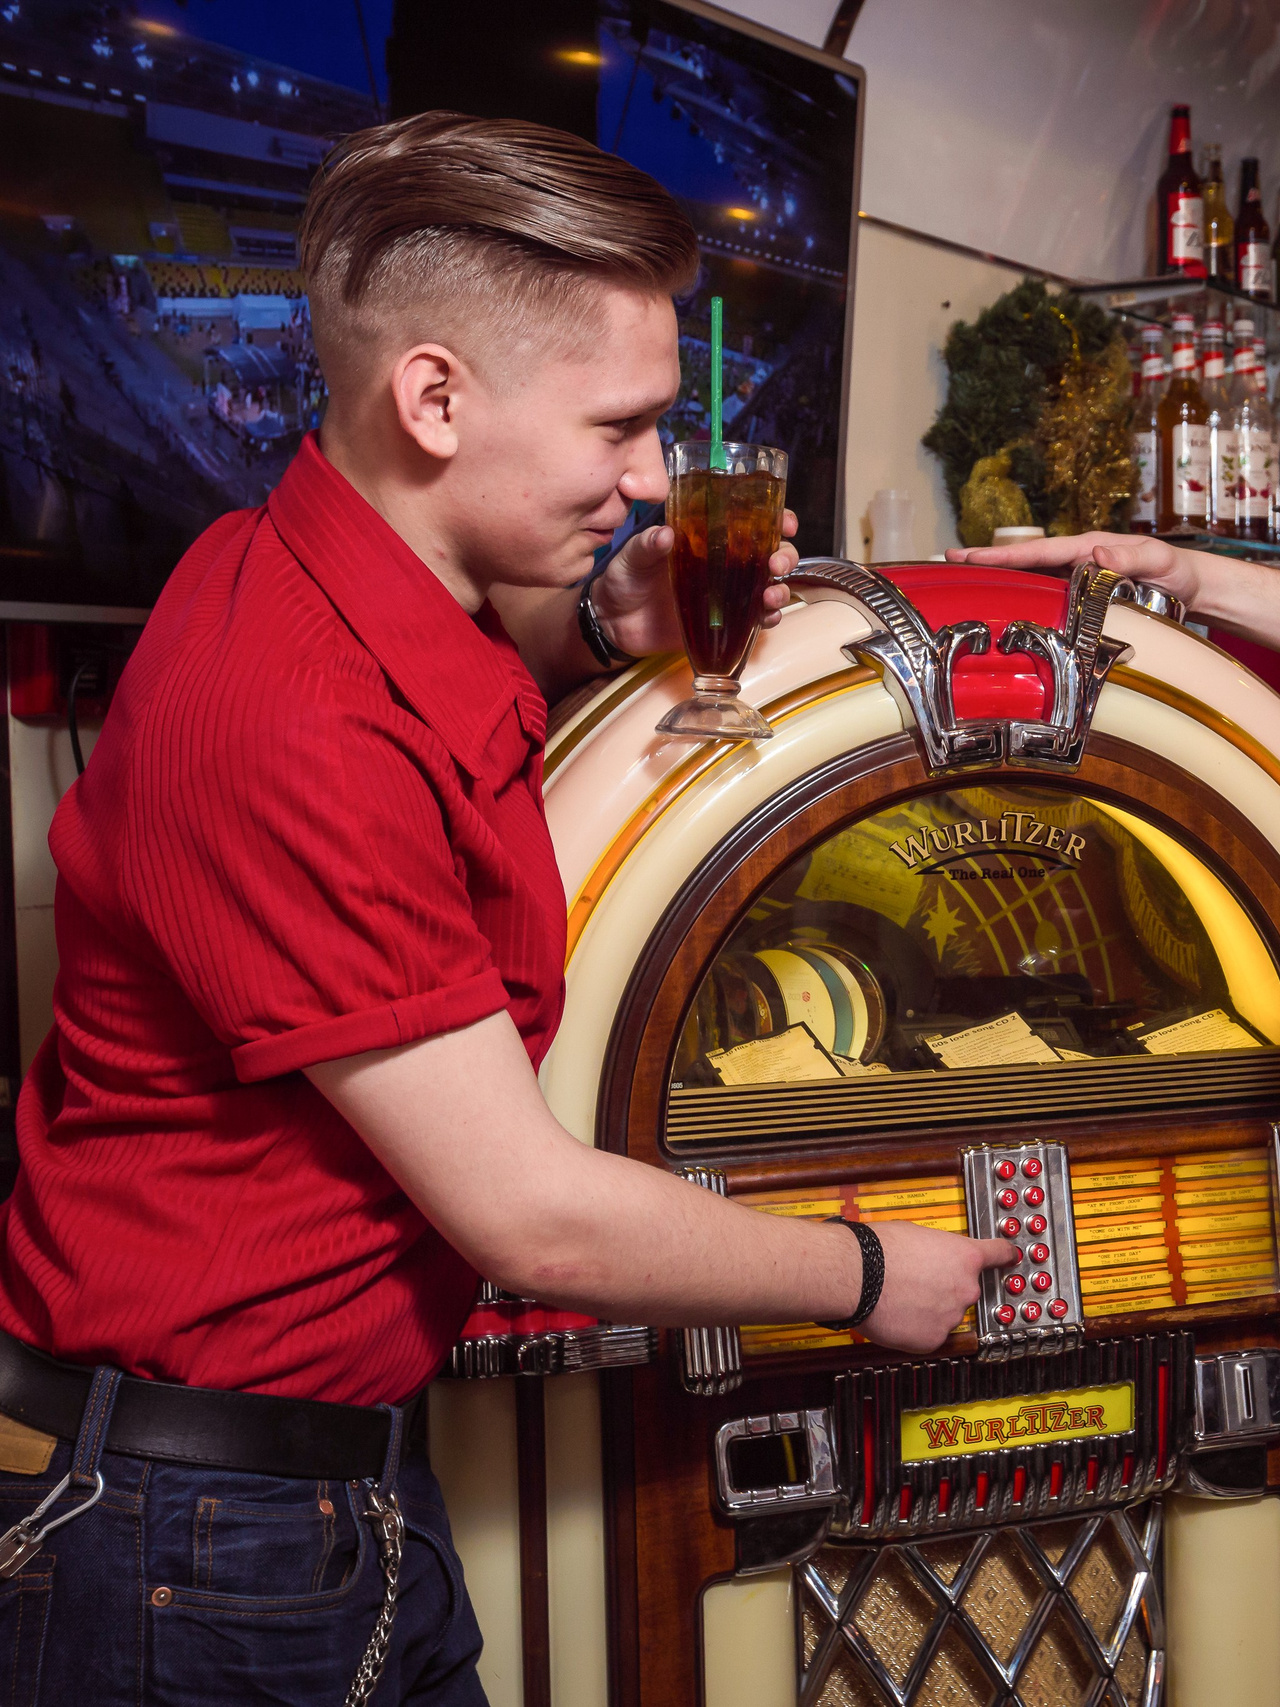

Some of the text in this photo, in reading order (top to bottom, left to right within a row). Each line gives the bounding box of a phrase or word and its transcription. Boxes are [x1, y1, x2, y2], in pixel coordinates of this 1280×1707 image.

[889, 811, 1086, 869] WURLITZER
[950, 866, 1045, 880] The Real One
[1158, 1026, 1178, 1037] love
[1180, 1018, 1202, 1029] song
[1202, 1012, 1215, 1021] CD
[932, 1040, 948, 1048] 60s
[949, 1032, 970, 1043] love
[972, 1024, 995, 1034] song
[996, 1018, 1010, 1028] CD
[1005, 1165, 1010, 1174] 1
[1031, 1163, 1038, 1172] 2
[1006, 1193, 1012, 1203] 3
[1032, 1191, 1038, 1200] 4
[1009, 1221, 1016, 1232] 5
[1034, 1220, 1041, 1229] 6
[1037, 1248, 1044, 1258] 8
[1014, 1278, 1021, 1289] 9
[1039, 1277, 1046, 1286] 0
[1029, 1306, 1037, 1318] R
[920, 1402, 1108, 1449] WURLITZER
